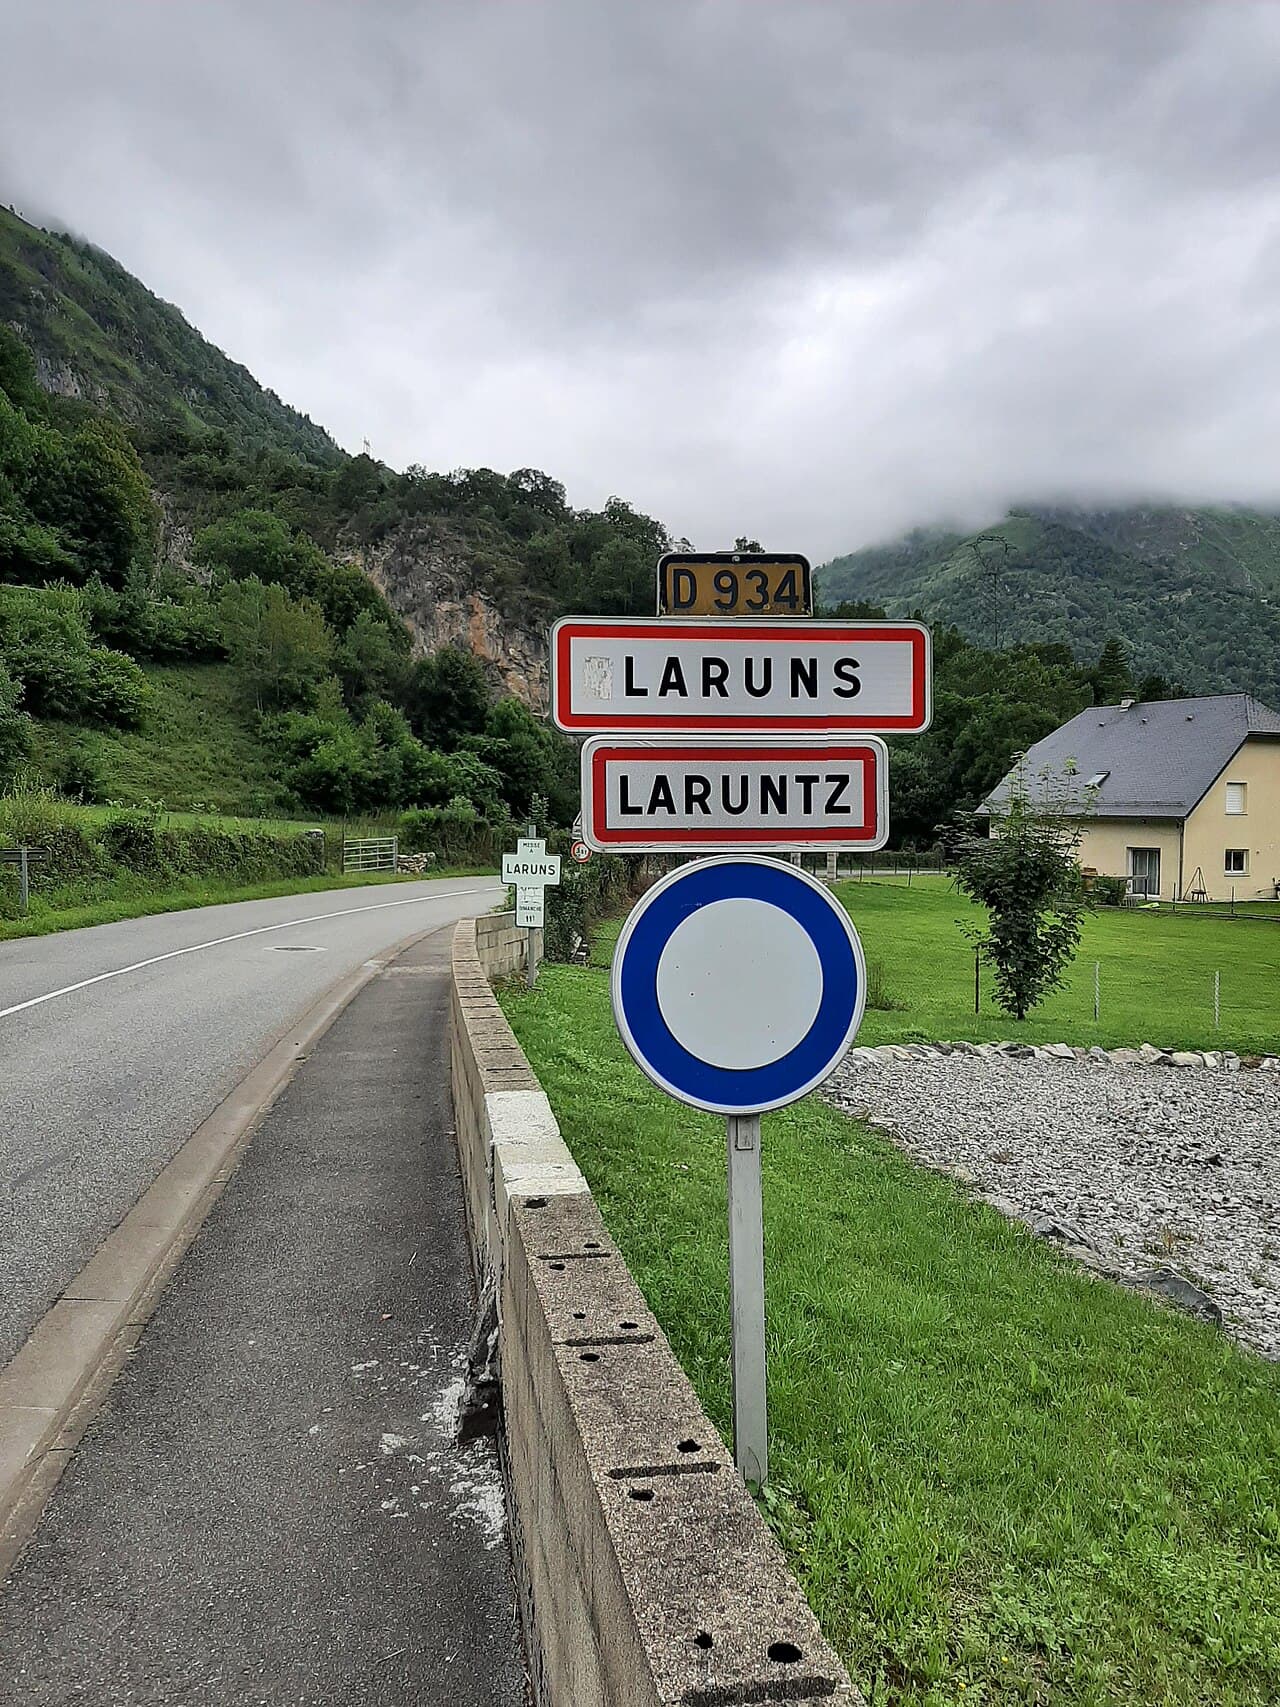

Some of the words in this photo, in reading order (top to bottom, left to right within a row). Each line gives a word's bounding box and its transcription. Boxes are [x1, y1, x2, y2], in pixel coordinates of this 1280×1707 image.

[672, 569, 698, 609] D
[713, 569, 799, 610] 934
[624, 656, 861, 698] LARUNS
[619, 774, 852, 815] LARUNTZ
[506, 863, 556, 875] LARUNS
